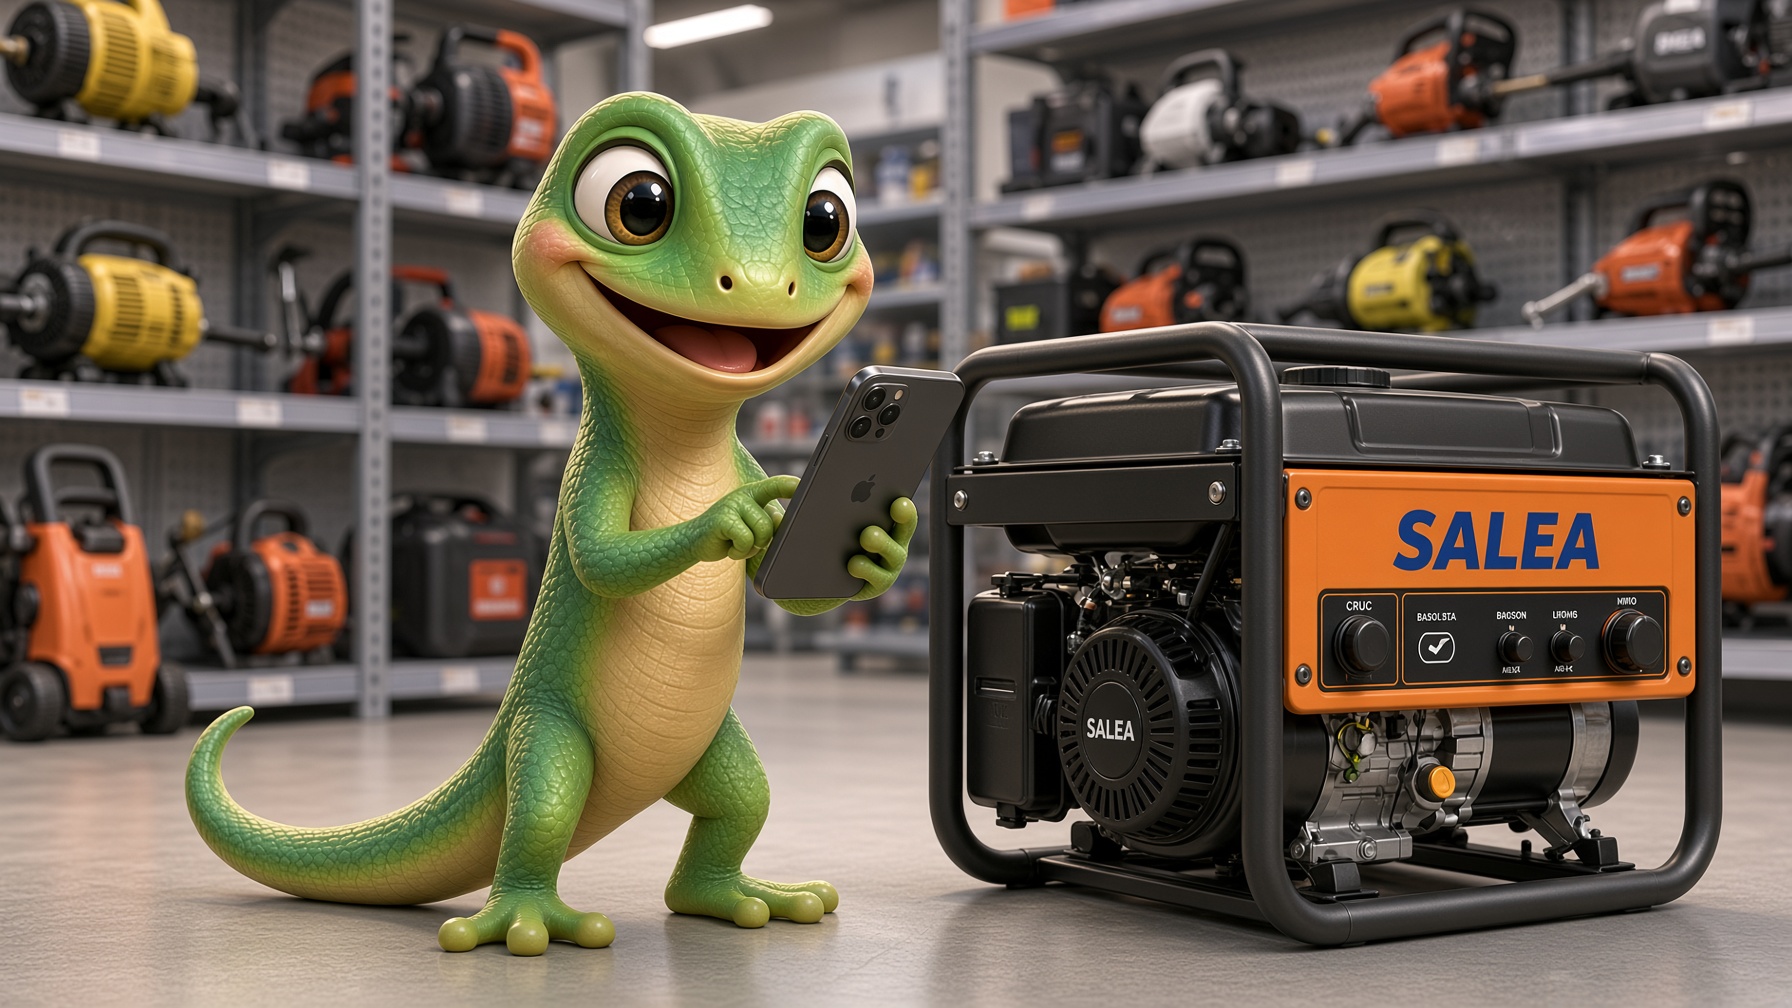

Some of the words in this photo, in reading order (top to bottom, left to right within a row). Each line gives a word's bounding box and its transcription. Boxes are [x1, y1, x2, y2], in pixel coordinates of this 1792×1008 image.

[1393, 509, 1600, 571] SALEA
[1346, 600, 1372, 611] CRUC
[1087, 717, 1135, 741] SALEA
